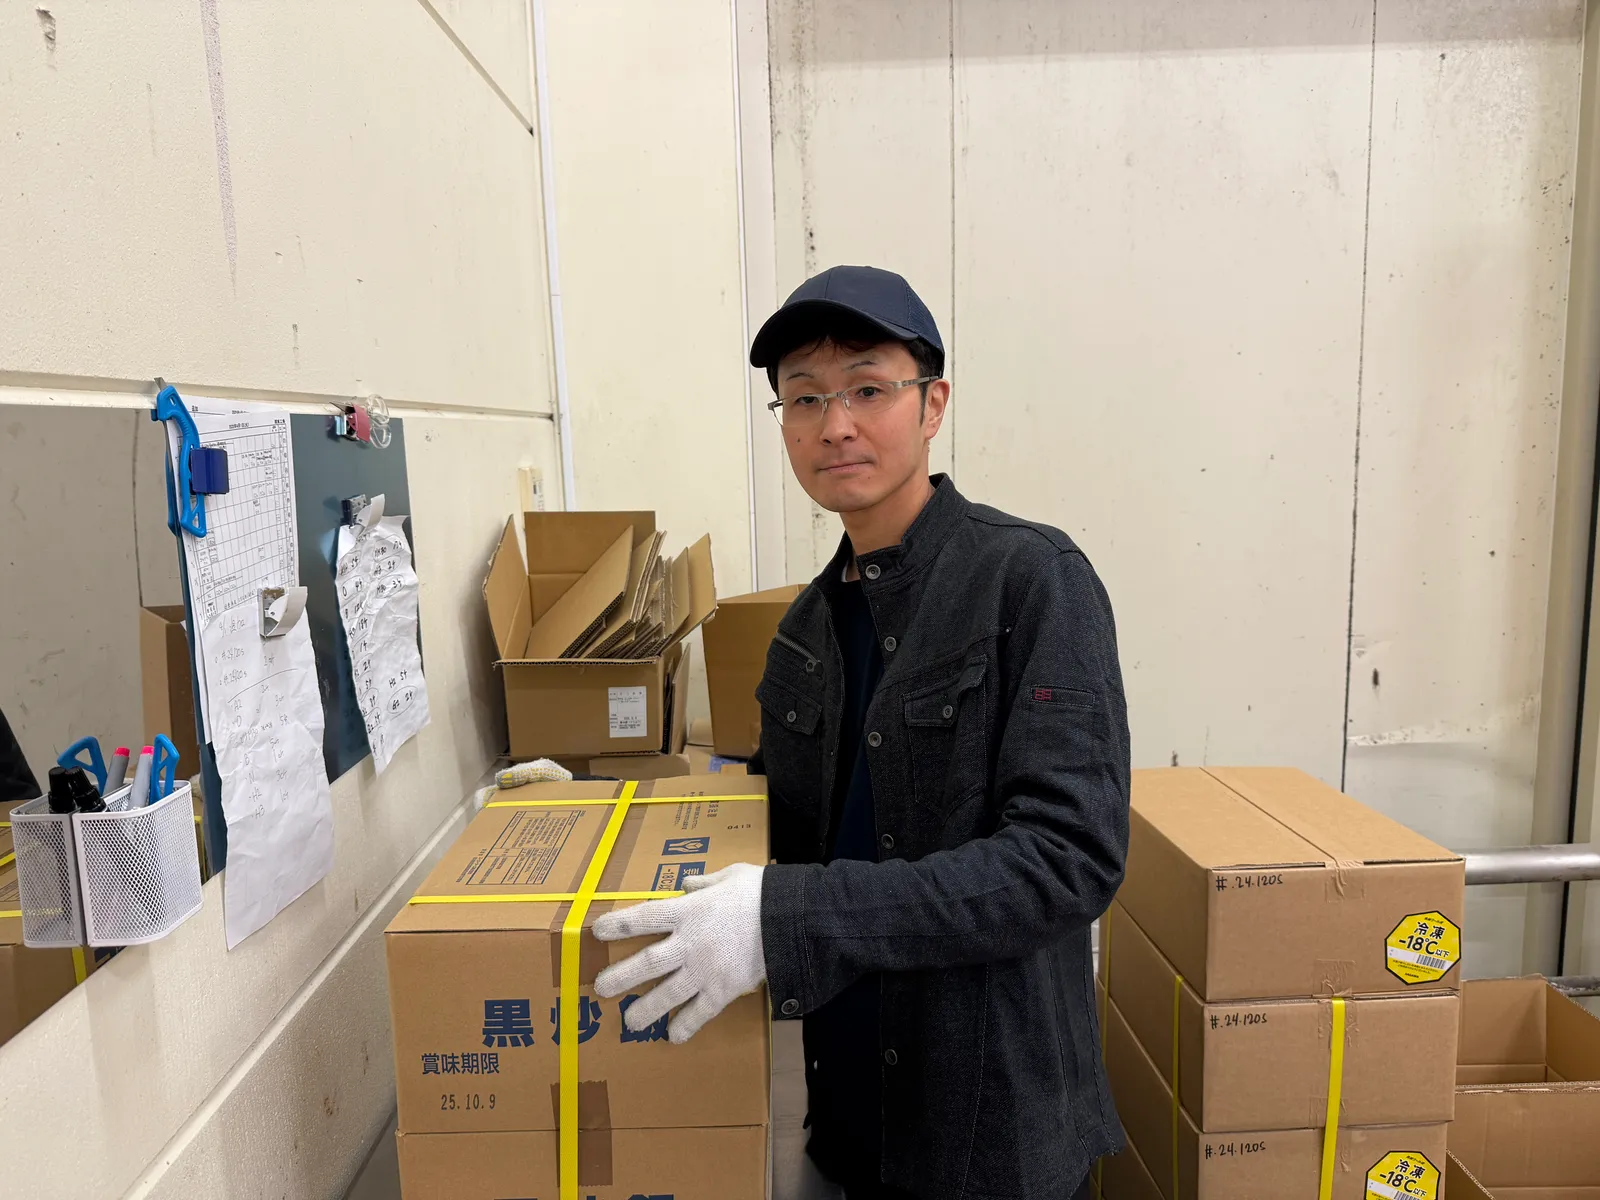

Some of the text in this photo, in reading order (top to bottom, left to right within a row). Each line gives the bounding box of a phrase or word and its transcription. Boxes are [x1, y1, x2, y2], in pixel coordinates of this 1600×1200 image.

[1414, 921, 1446, 940] 冷凍
[421, 1052, 500, 1075] 賞味期限
[1395, 1159, 1426, 1179] 冷凍
